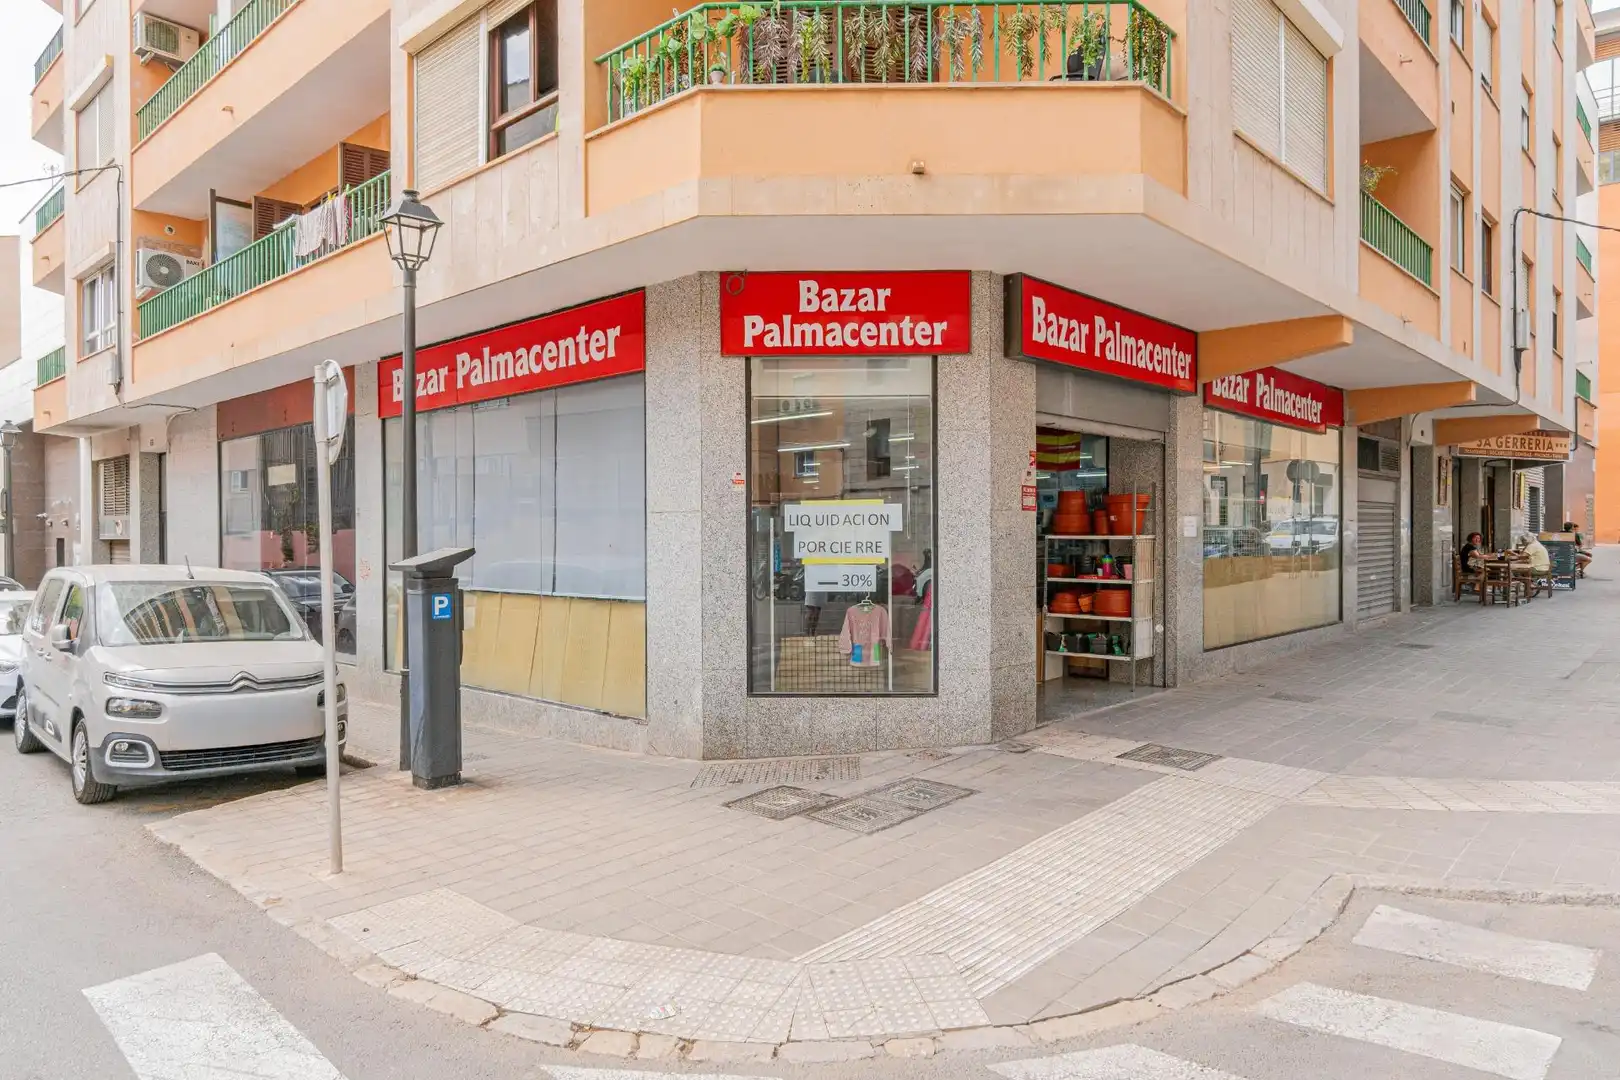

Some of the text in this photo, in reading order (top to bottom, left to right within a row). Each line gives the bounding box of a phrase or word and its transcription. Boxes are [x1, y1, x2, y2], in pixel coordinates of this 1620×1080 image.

[798, 280, 891, 313] Bazar
[743, 314, 948, 348] Palmacenter
[1031, 295, 1192, 380] Bazar Palmacenter
[392, 325, 620, 402] Bzar Palmacenter
[1255, 372, 1322, 424] Palmacenter
[1495, 435, 1554, 451] GERRERIA
[798, 541, 882, 554] POR CIERRE
[434, 596, 449, 615] P
